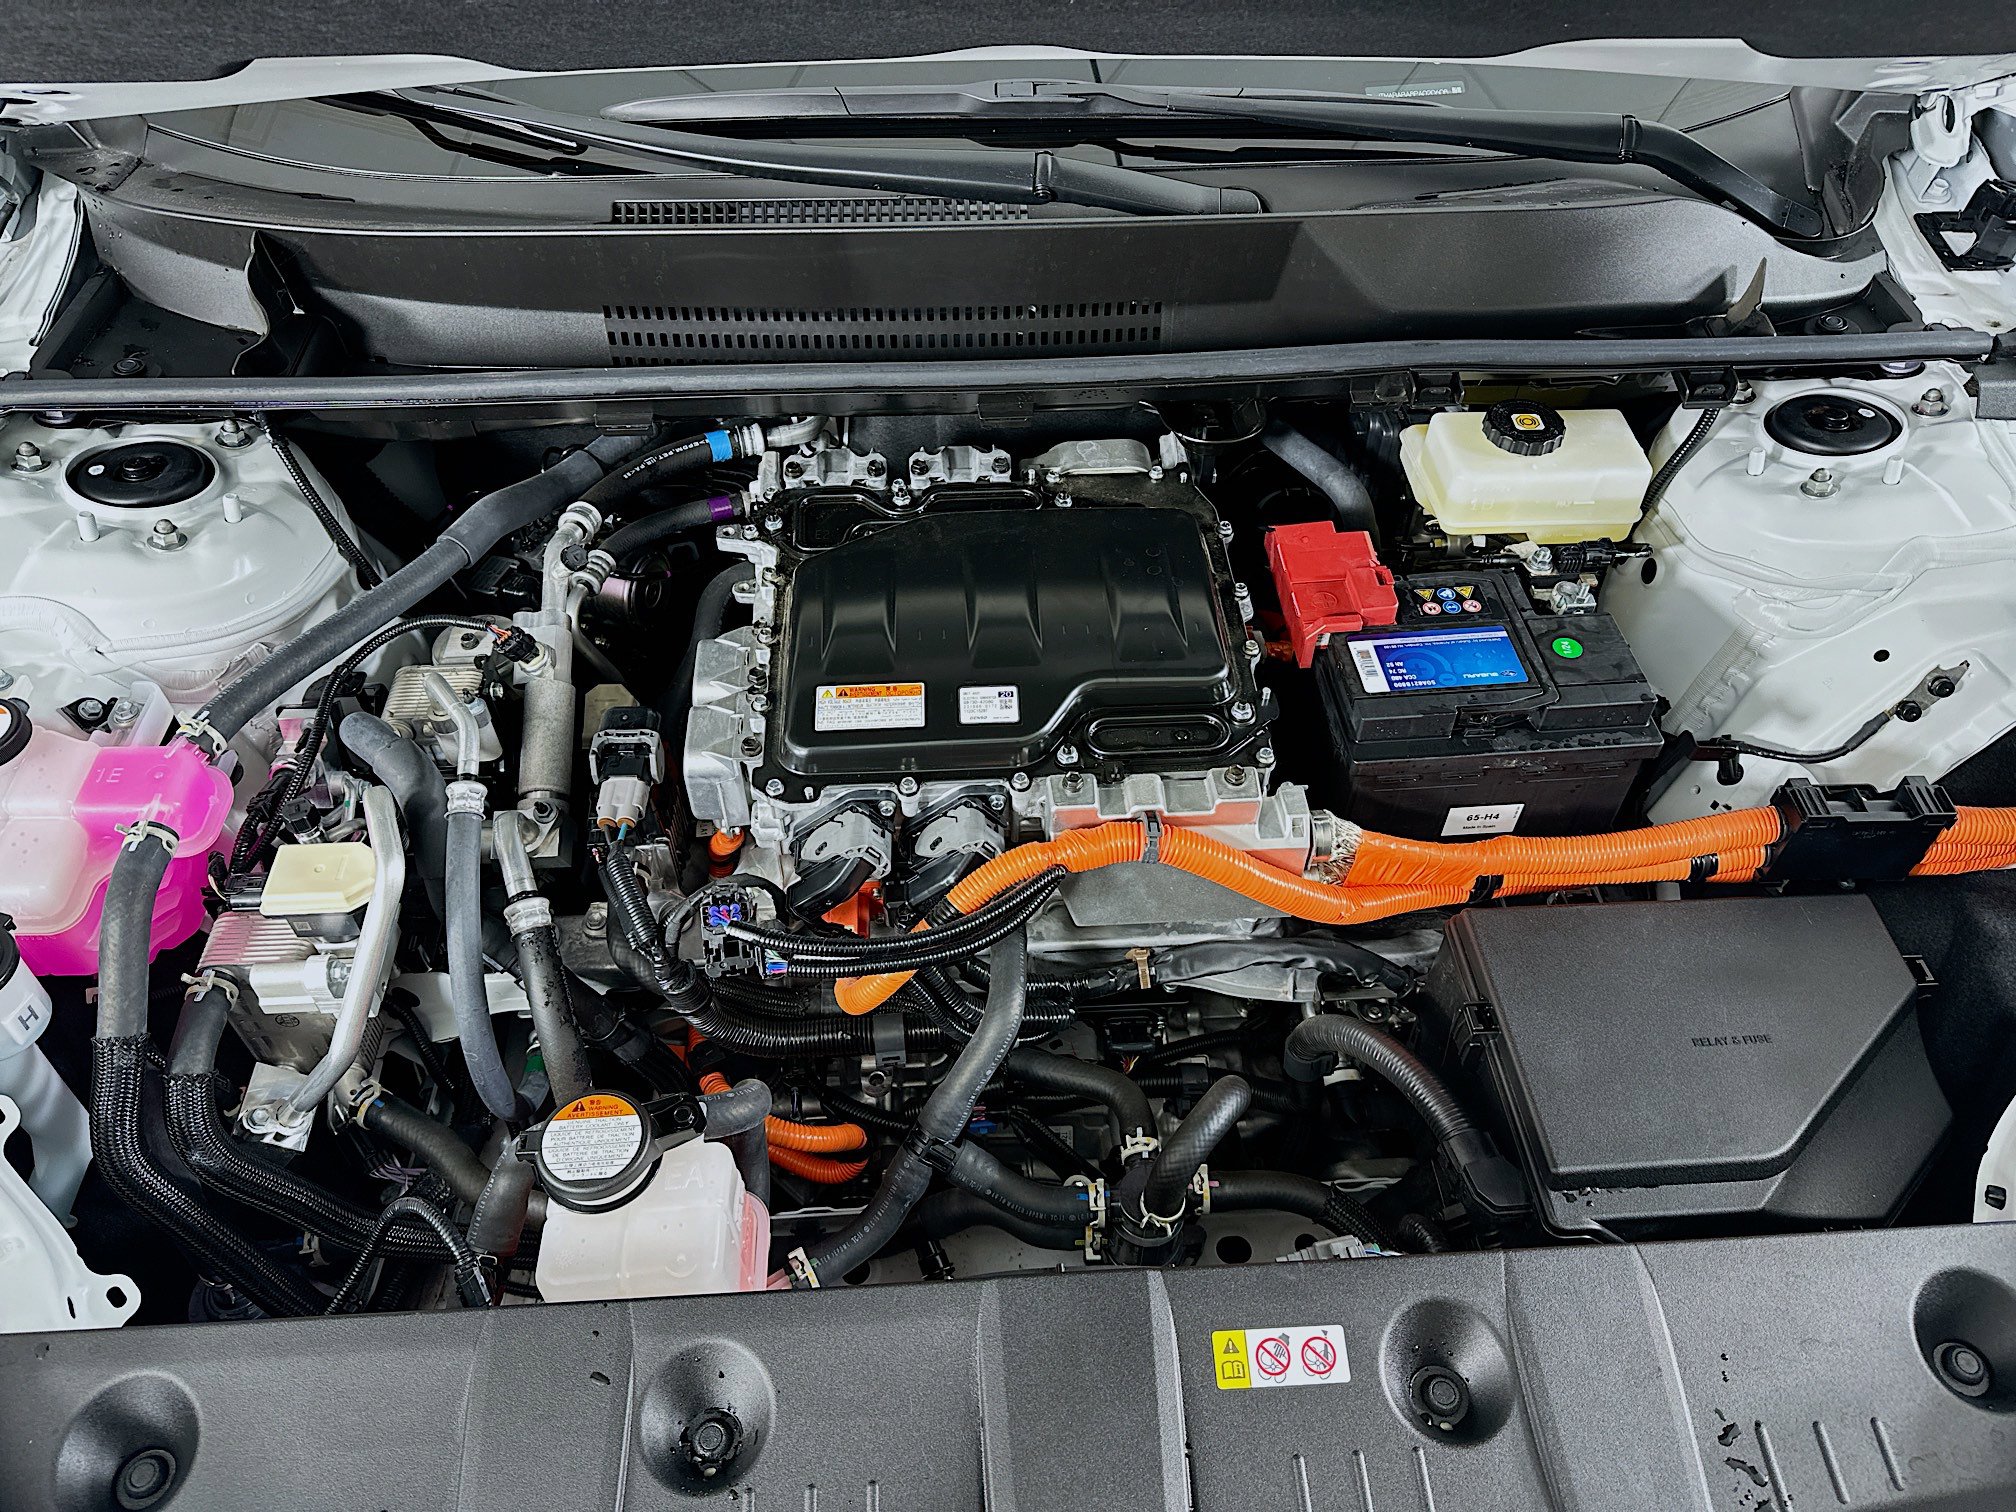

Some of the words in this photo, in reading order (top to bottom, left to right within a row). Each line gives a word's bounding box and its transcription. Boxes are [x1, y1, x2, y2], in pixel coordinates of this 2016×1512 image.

[1692, 1036, 1728, 1046] RELAY
[1732, 1036, 1740, 1044] &
[1742, 1034, 1773, 1044] FUSE
[568, 1110, 623, 1118] AVERTISSEMENT
